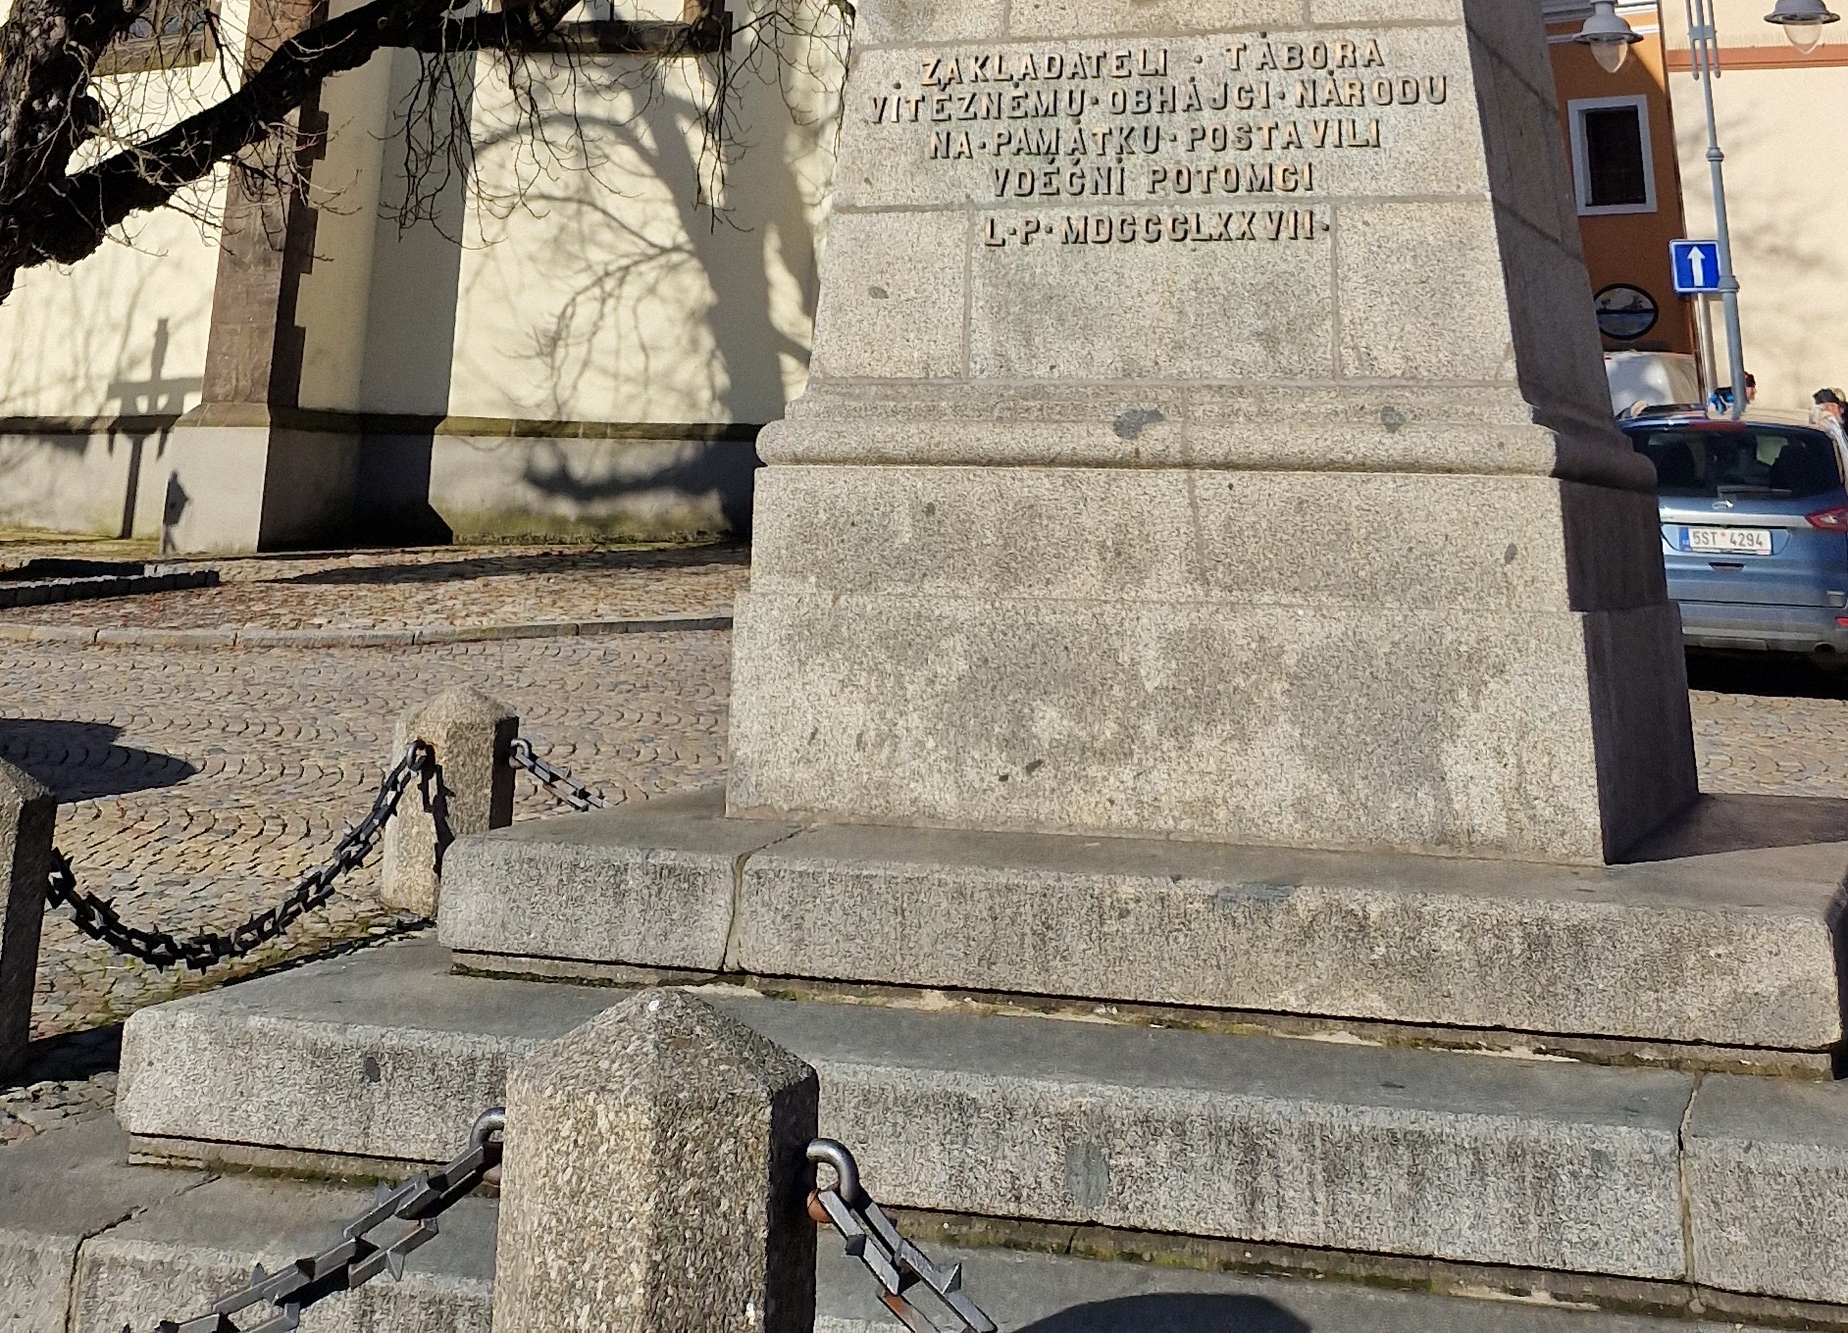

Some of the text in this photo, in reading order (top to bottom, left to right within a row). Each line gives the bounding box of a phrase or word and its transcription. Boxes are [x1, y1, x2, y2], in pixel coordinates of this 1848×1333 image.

[1147, 161, 1314, 195] POTOMCI
[1692, 531, 1718, 546] 5ST
[1729, 532, 1763, 547] 4294
